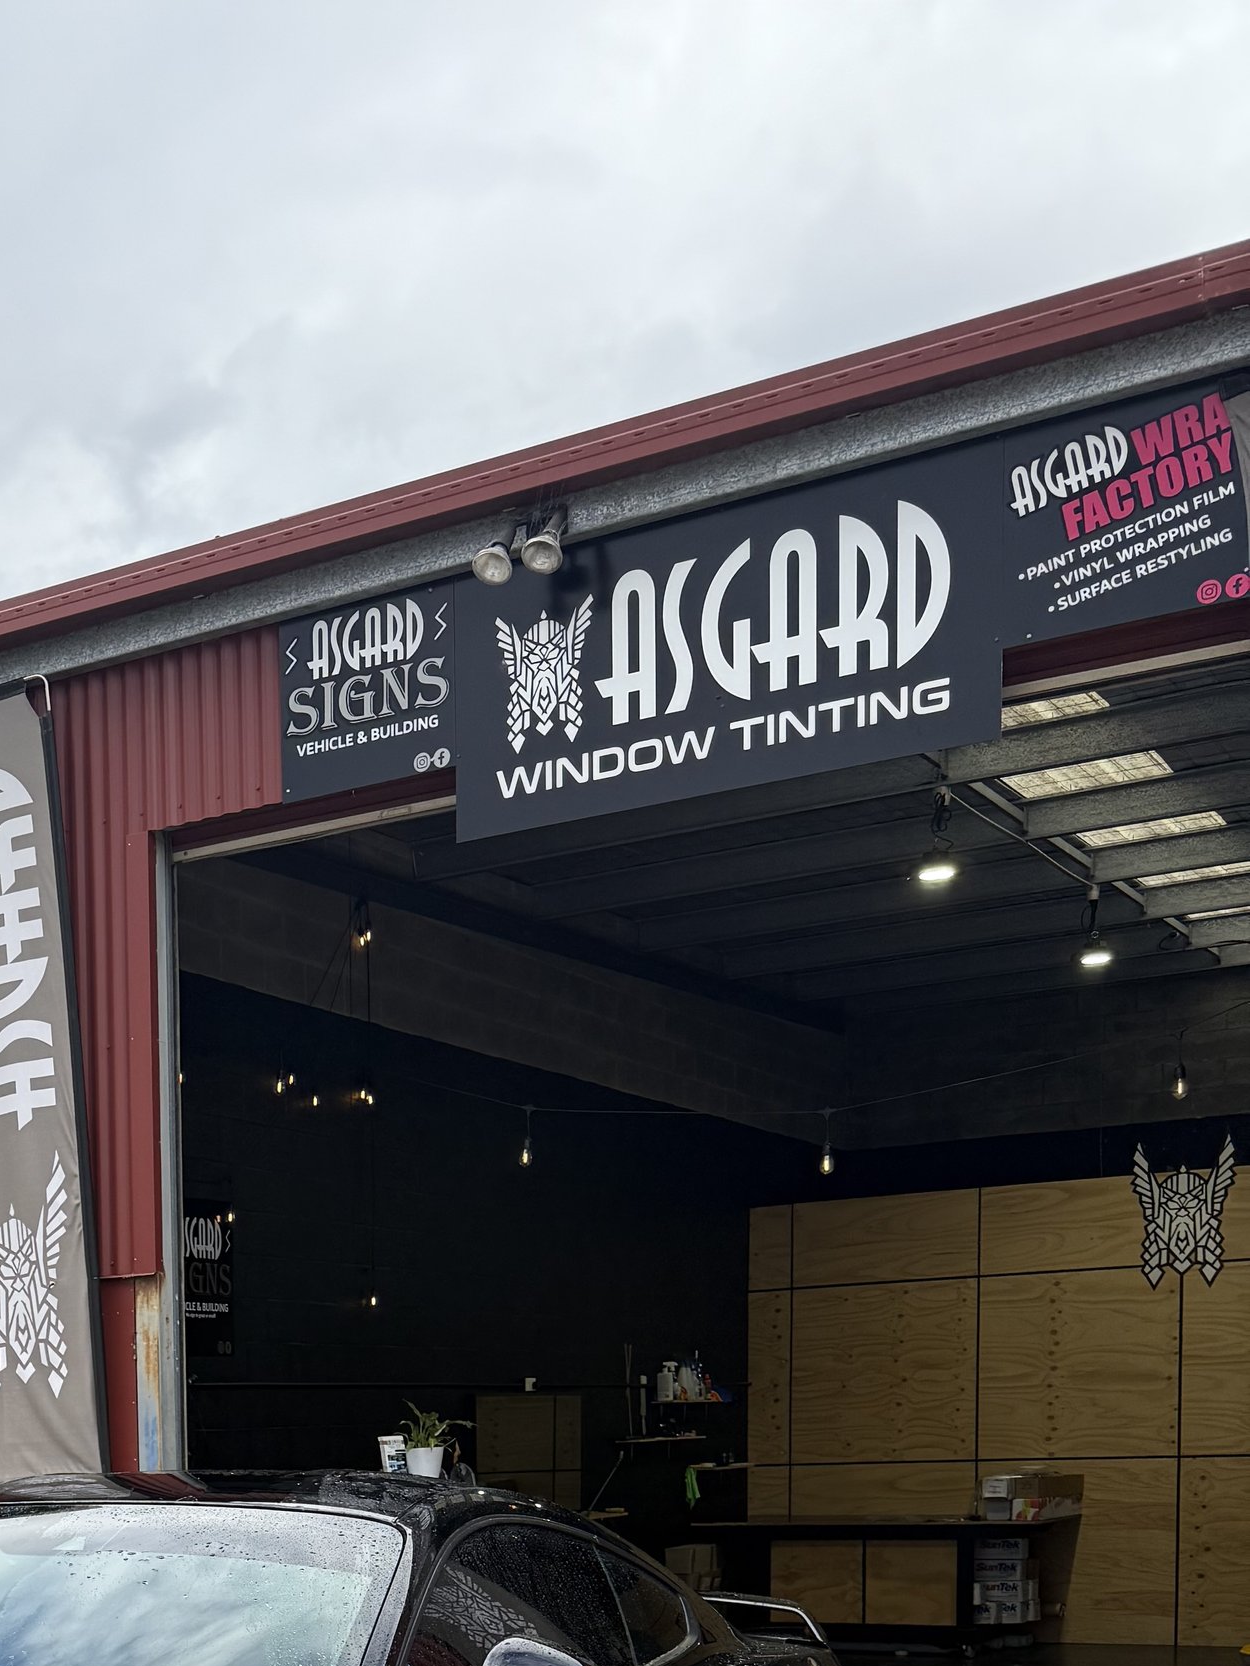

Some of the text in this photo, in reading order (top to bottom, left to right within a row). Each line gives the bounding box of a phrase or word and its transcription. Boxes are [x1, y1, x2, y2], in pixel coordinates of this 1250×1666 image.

[1010, 393, 1232, 517] ASGARD WRA
[1061, 430, 1233, 541] FACTORY
[1026, 482, 1236, 581] PAINT PROTECTION FILM
[1058, 528, 1233, 611] SURFACE RESTYLING
[1061, 514, 1212, 588] VINYL WRAPPING
[306, 598, 424, 680] ASGARD
[594, 500, 950, 726] ASGARD
[286, 656, 450, 737] SIGNS
[296, 714, 439, 757] VEHICLE & BUILDING
[495, 678, 950, 799] WINDOW TINTING
[185, 1216, 222, 1260] SGARD
